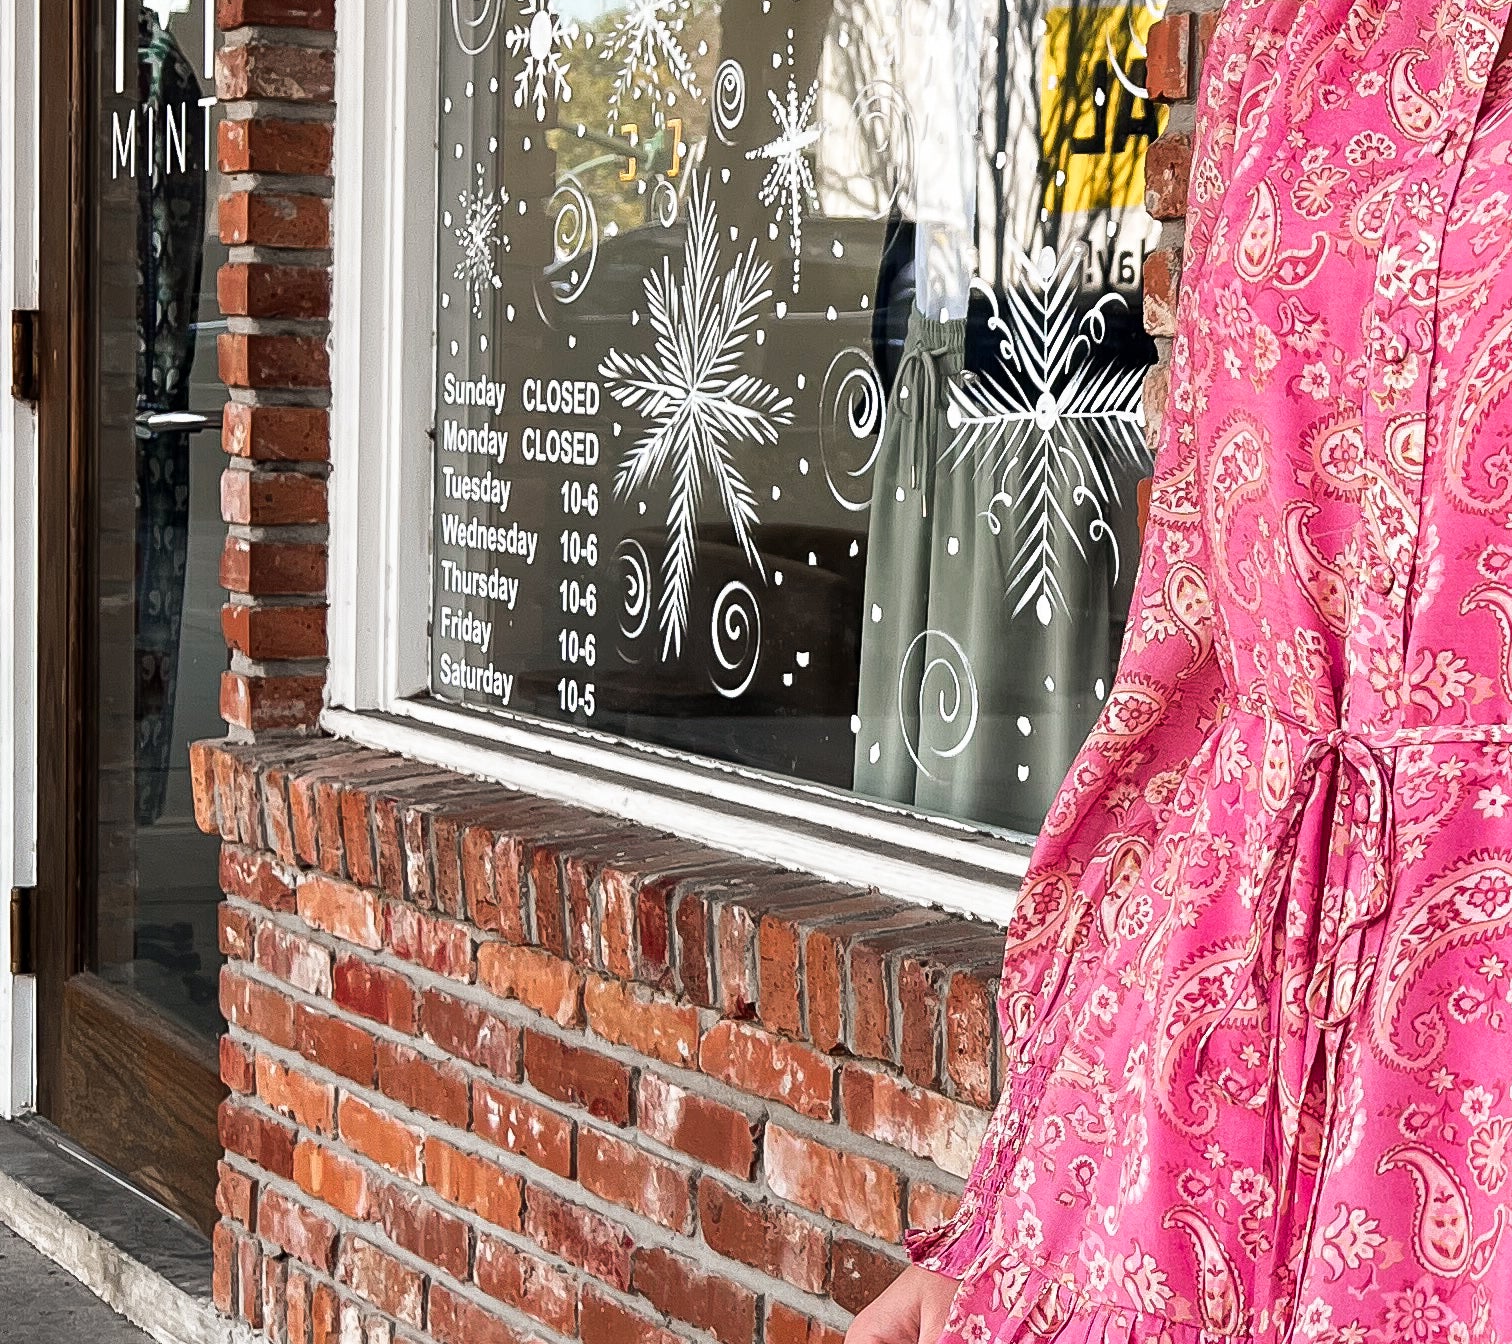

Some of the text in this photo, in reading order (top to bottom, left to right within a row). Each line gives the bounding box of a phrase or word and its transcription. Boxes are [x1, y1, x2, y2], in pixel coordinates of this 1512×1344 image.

[112, 96, 218, 179] MINT
[442, 372, 601, 416] Sunday CLOSED
[442, 419, 600, 466] Monday CLOSED
[442, 466, 600, 517] Tuesday 10-6
[440, 512, 599, 567] Wednesday 10-6
[440, 559, 598, 617] Thursday 10-6
[439, 608, 597, 667] Friday 10-6
[438, 653, 596, 717] Saturday 10-5
